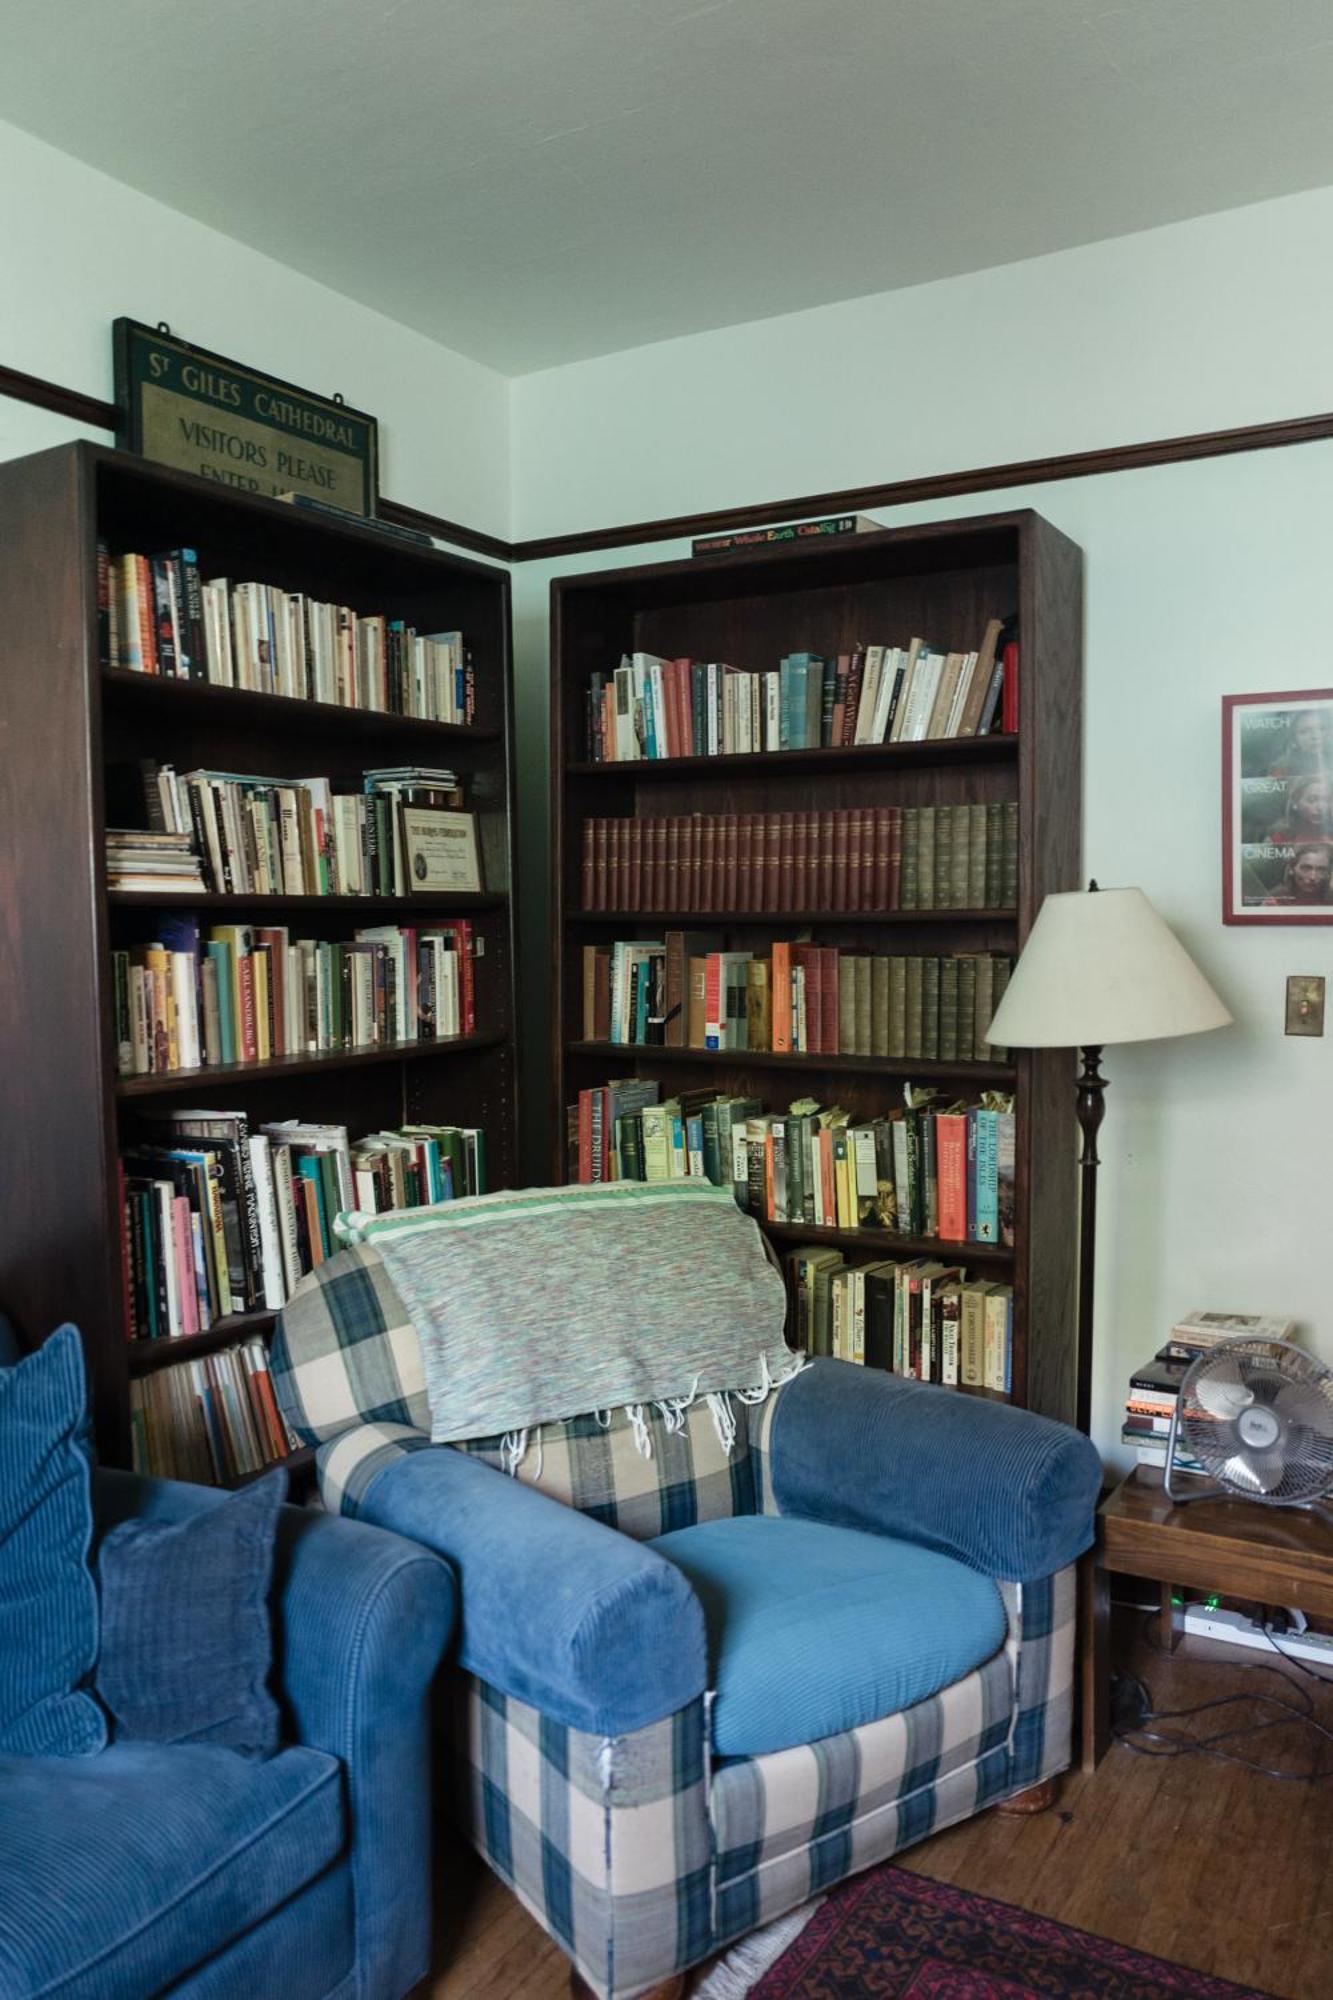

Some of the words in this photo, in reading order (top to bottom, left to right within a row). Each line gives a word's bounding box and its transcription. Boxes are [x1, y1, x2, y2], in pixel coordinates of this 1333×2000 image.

[181, 366, 242, 407] GILES
[254, 393, 358, 449] CATHEDRAL
[179, 417, 268, 468] VISITORS
[277, 451, 337, 491] PLEASE
[1245, 717, 1291, 730] WATCH
[1244, 780, 1288, 793] GREAT
[1243, 847, 1296, 860] CINEMA
